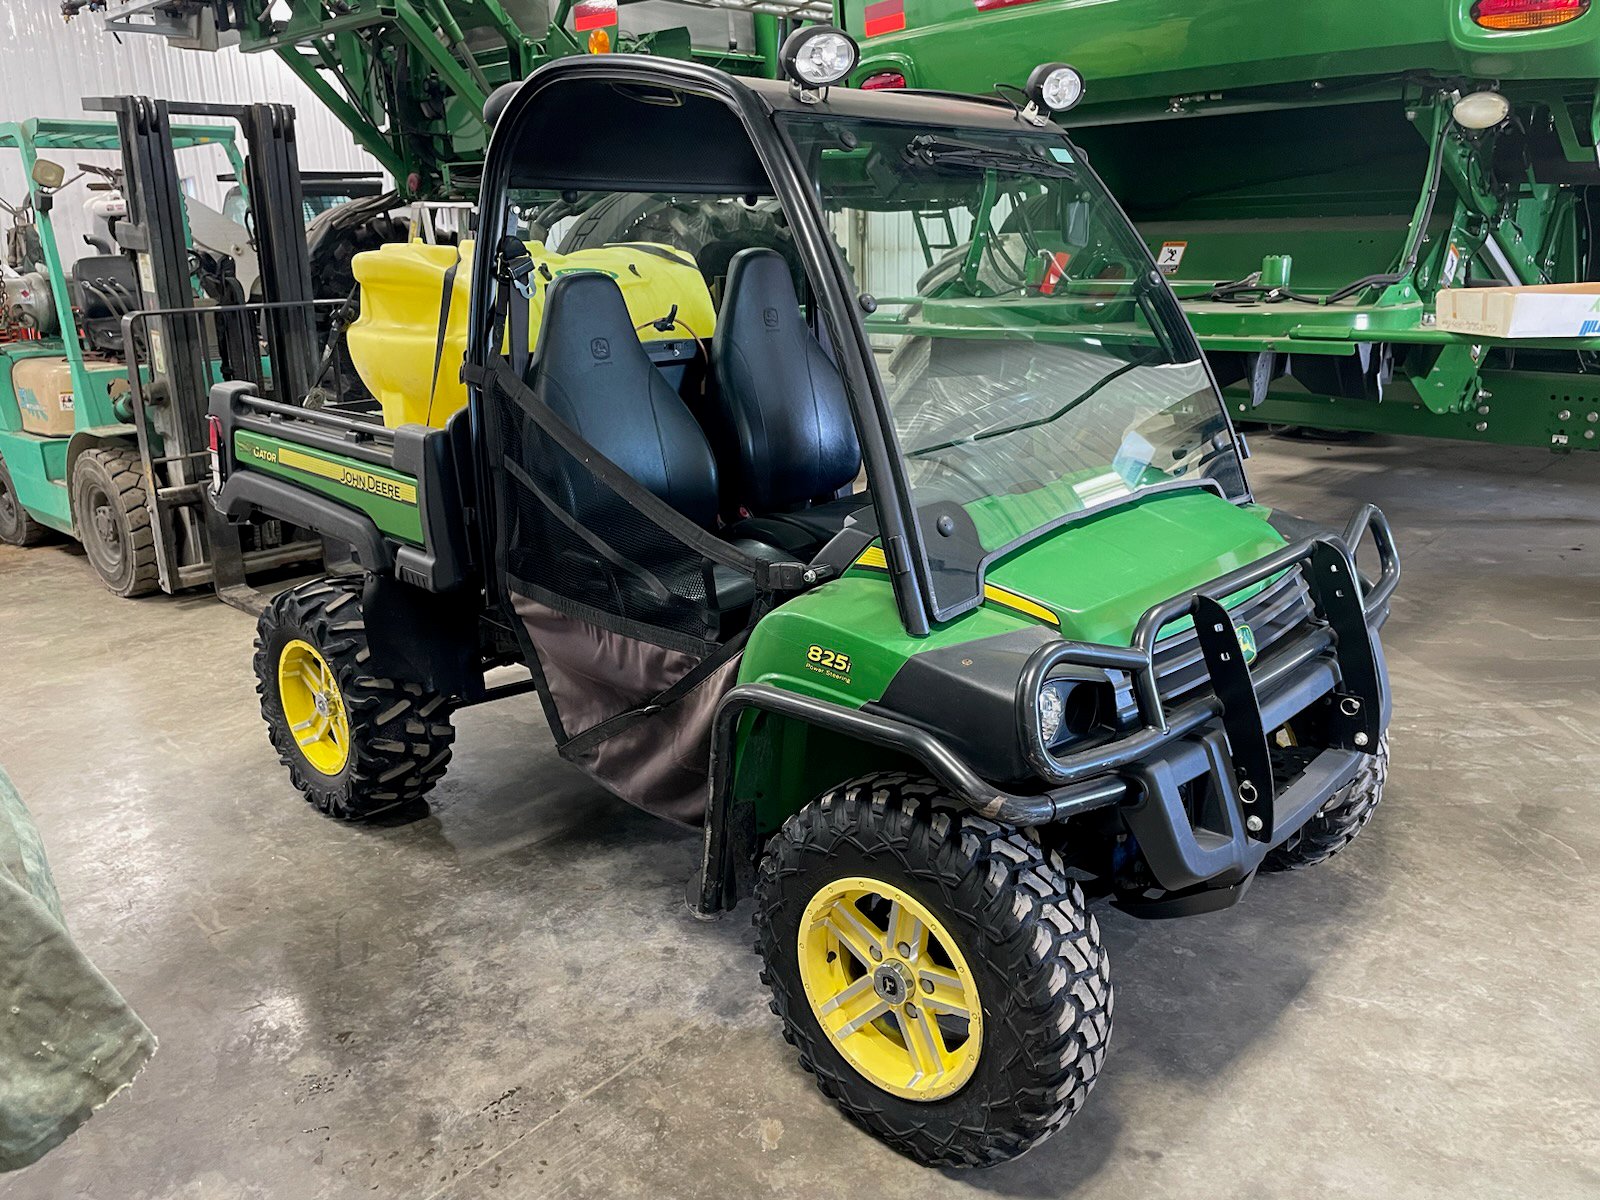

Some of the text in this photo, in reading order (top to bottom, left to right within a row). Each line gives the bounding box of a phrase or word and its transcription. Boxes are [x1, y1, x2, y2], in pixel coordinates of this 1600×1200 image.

[253, 447, 277, 463] GATOR
[340, 468, 400, 499] JOHN DEERE
[807, 645, 852, 673] 825i
[805, 662, 851, 684] Power Steering
